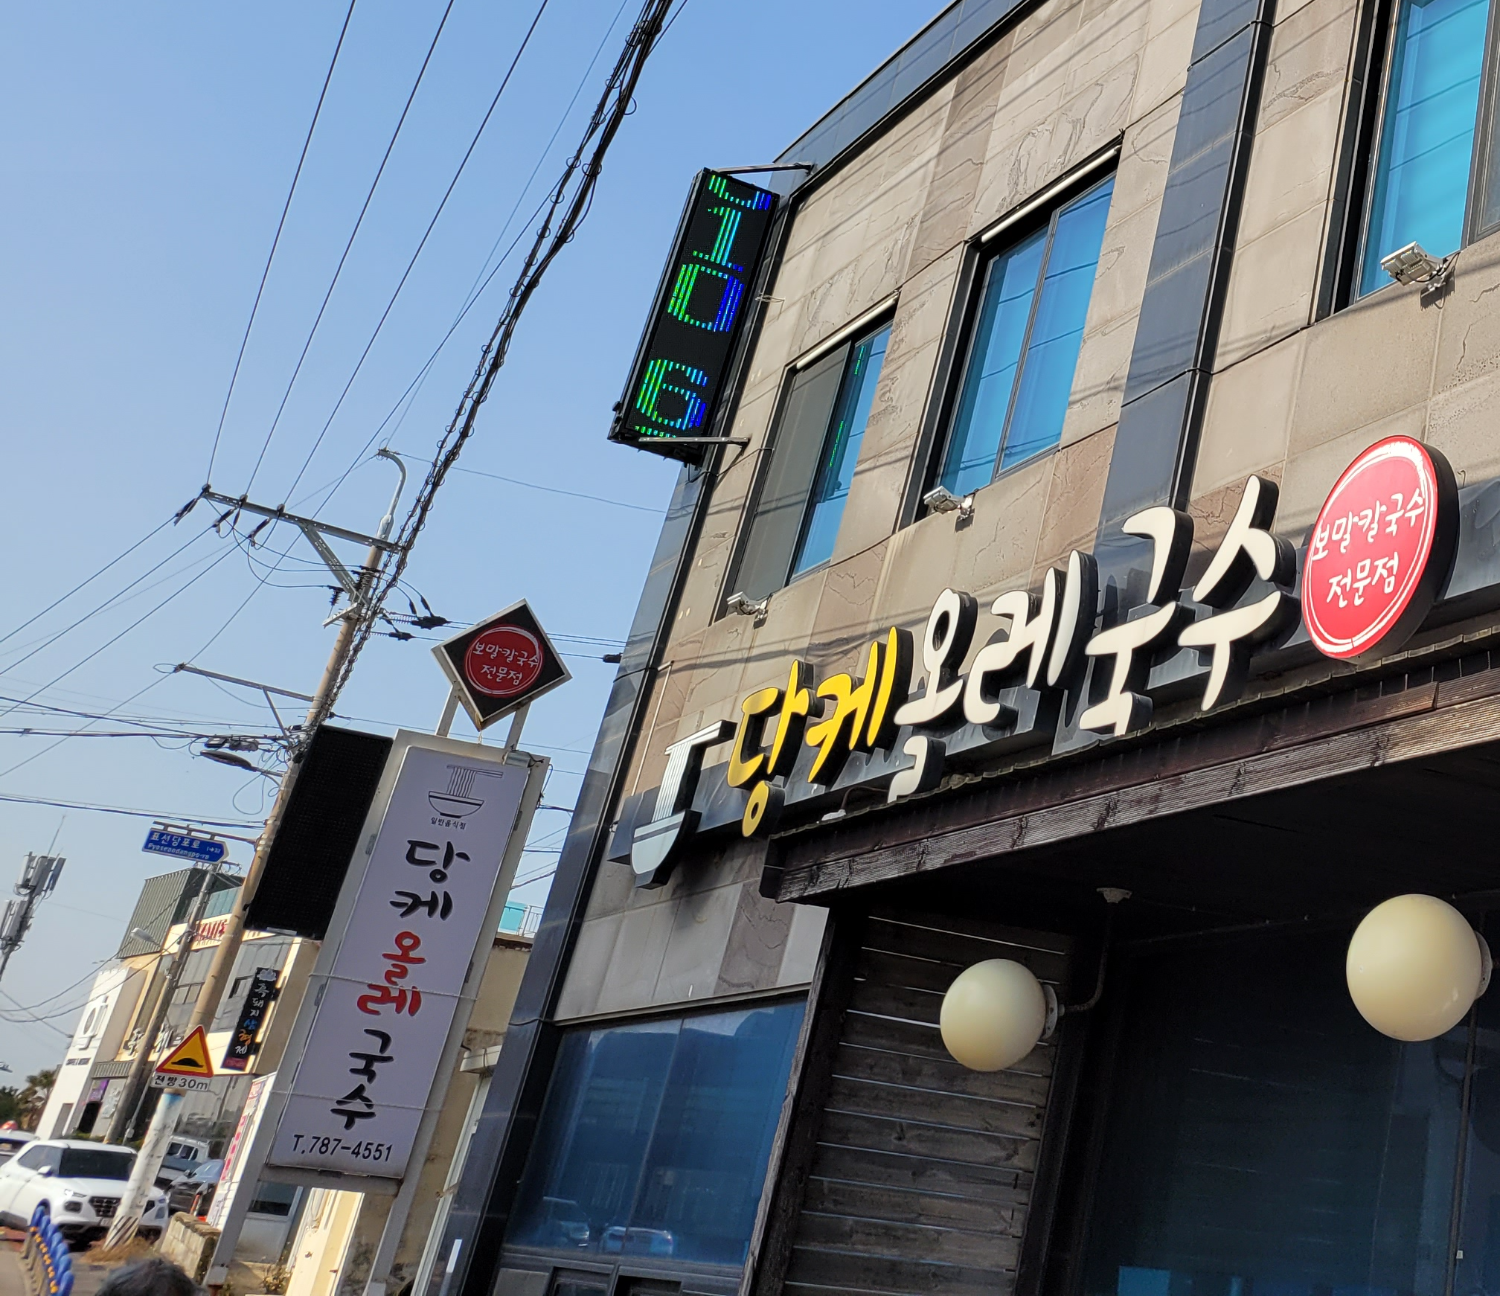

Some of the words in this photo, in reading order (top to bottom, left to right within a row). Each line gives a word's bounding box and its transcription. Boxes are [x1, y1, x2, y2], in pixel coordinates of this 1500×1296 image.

[1312, 487, 1425, 561] 보말칼국수
[1327, 551, 1399, 608] 전문점
[473, 641, 539, 668] 보말칼국수
[480, 664, 523, 685] 전문점
[430, 816, 467, 830] 일반음식점
[150, 831, 201, 849] 표선당포로
[154, 1074, 178, 1087] 전방
[178, 1077, 208, 1090] 30m
[292, 1133, 392, 1162] T.787-4551
